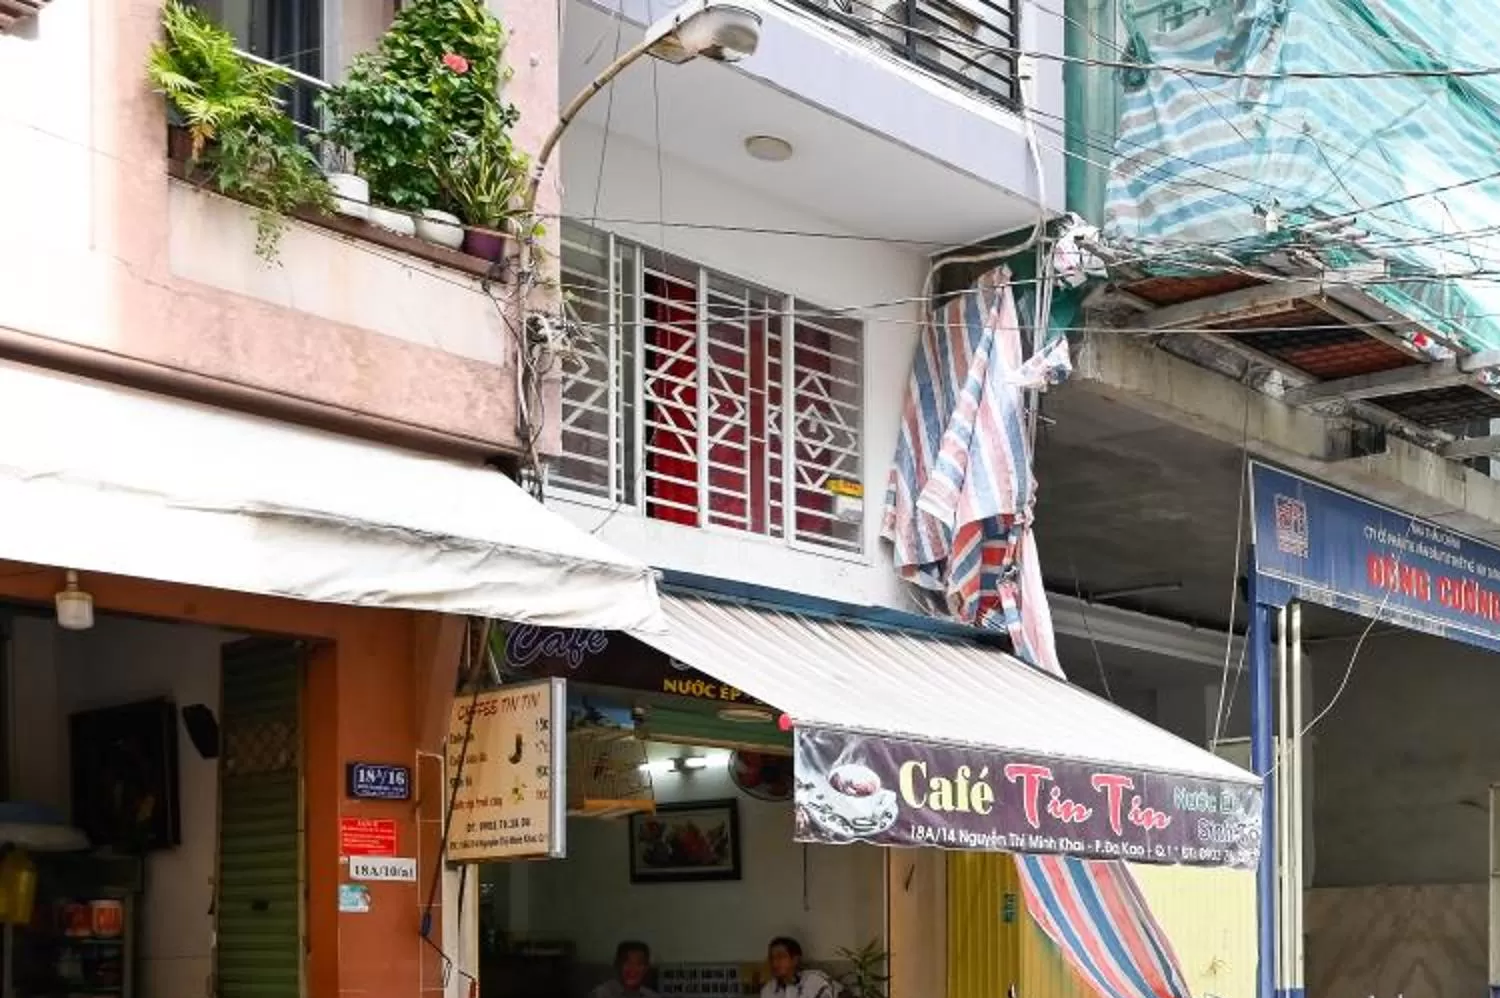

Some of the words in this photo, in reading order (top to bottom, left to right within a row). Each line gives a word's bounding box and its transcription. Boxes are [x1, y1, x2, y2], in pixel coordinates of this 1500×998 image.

[900, 760, 994, 815] Café
[1004, 763, 1092, 829] Tin
[1091, 773, 1172, 837] Tin
[910, 824, 957, 843] 18A/14
[1026, 834, 1057, 850] Minh
[1059, 837, 1084, 851] Khai
